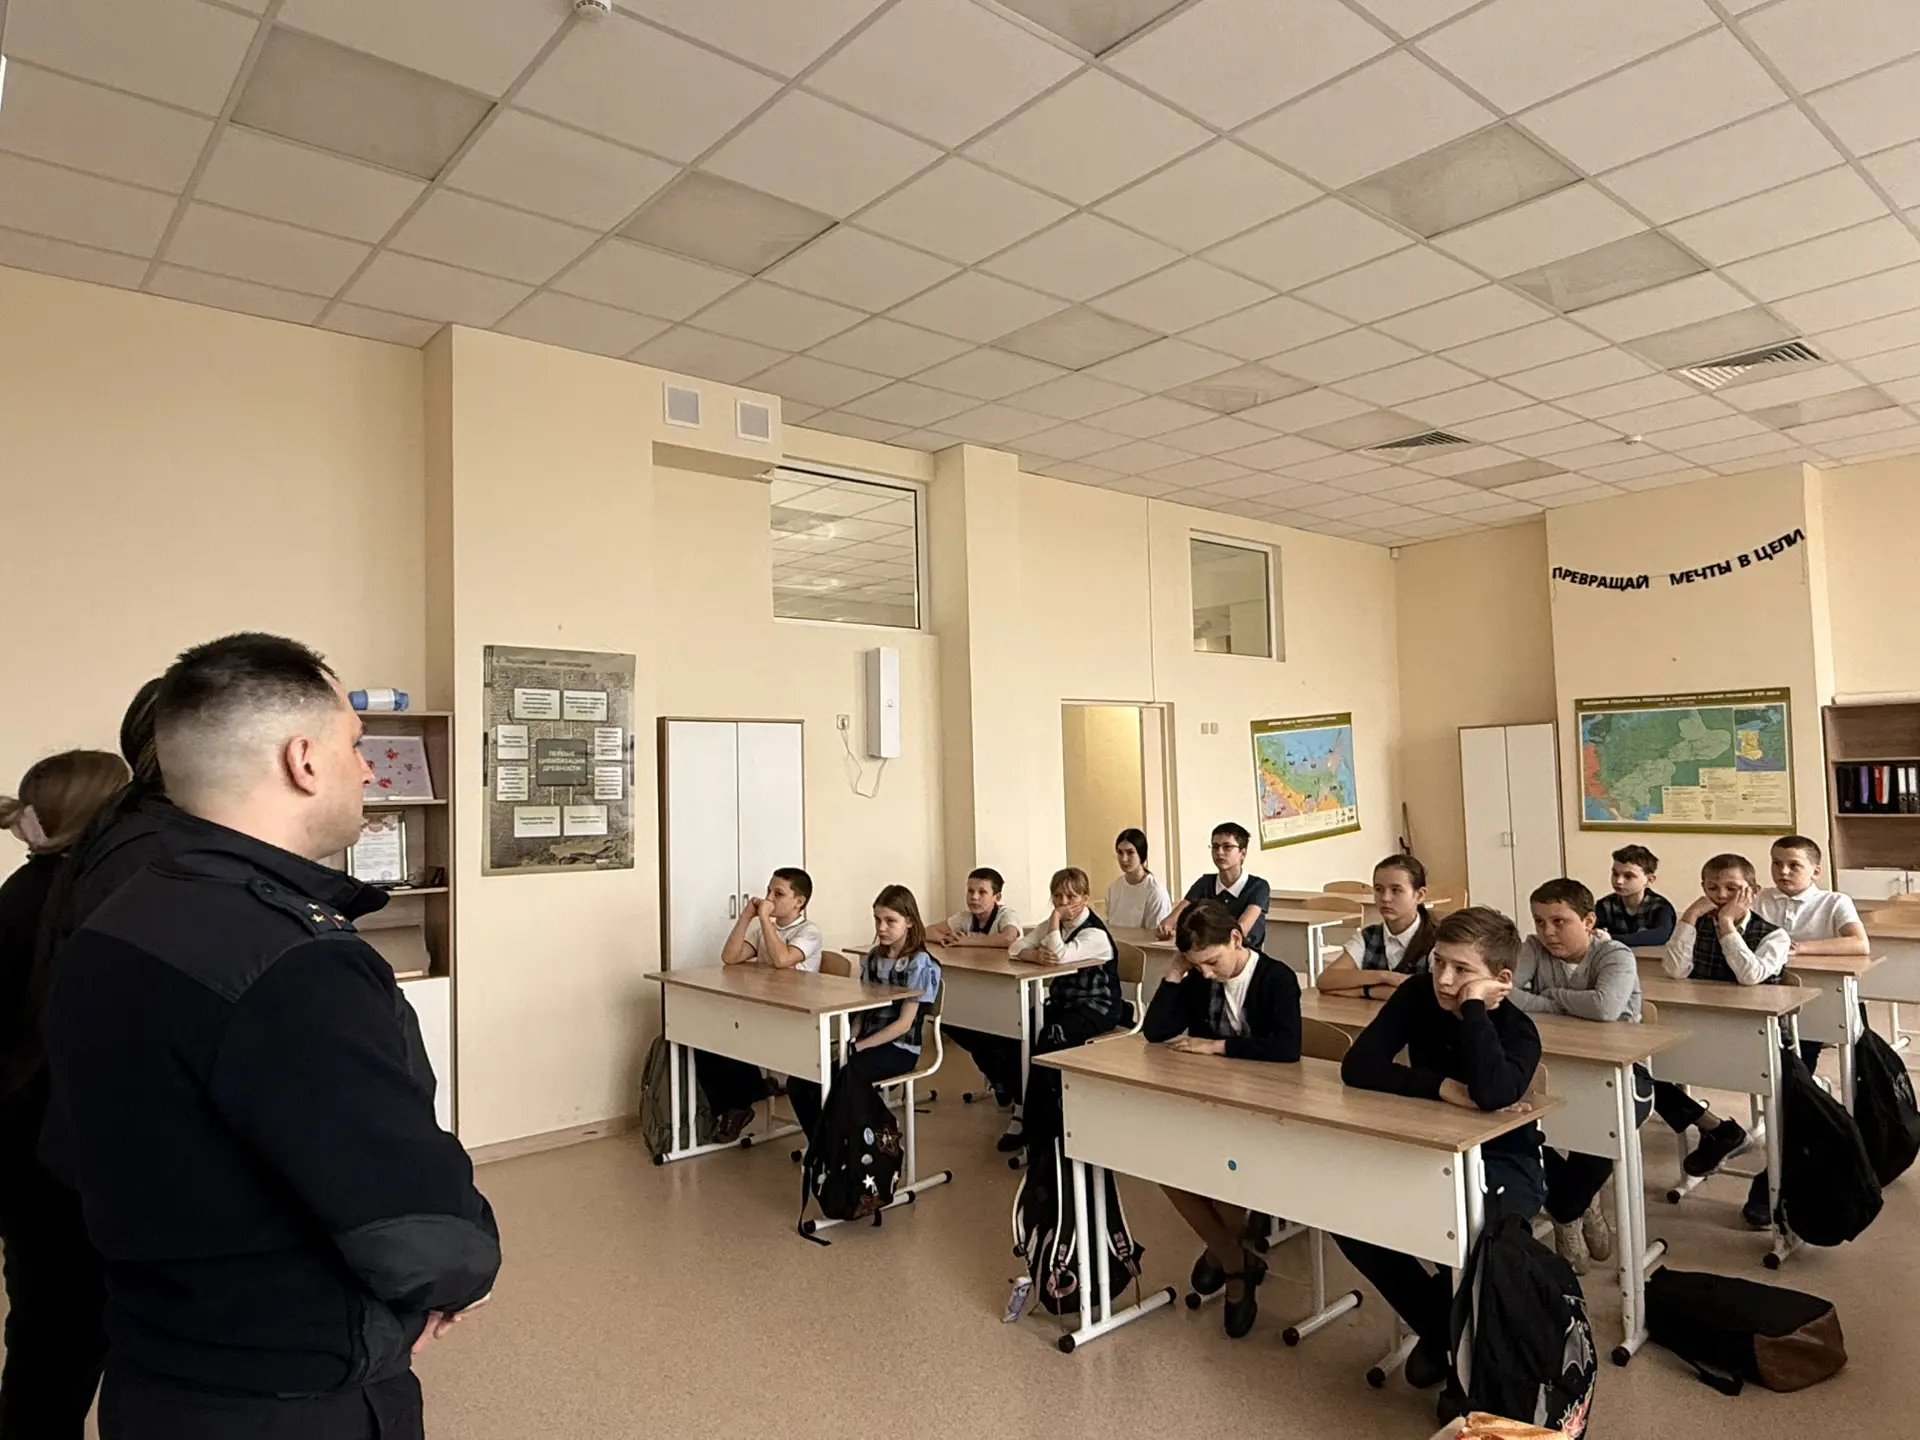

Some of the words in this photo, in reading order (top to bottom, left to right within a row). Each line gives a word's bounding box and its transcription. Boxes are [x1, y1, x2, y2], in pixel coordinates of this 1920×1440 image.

[1552, 567, 1649, 591] ПРЕВРАЩАЙ
[1669, 560, 1732, 586] МЕЧТЫ
[1737, 554, 1751, 569] В
[1753, 528, 1805, 561] ЦЕЛИ
